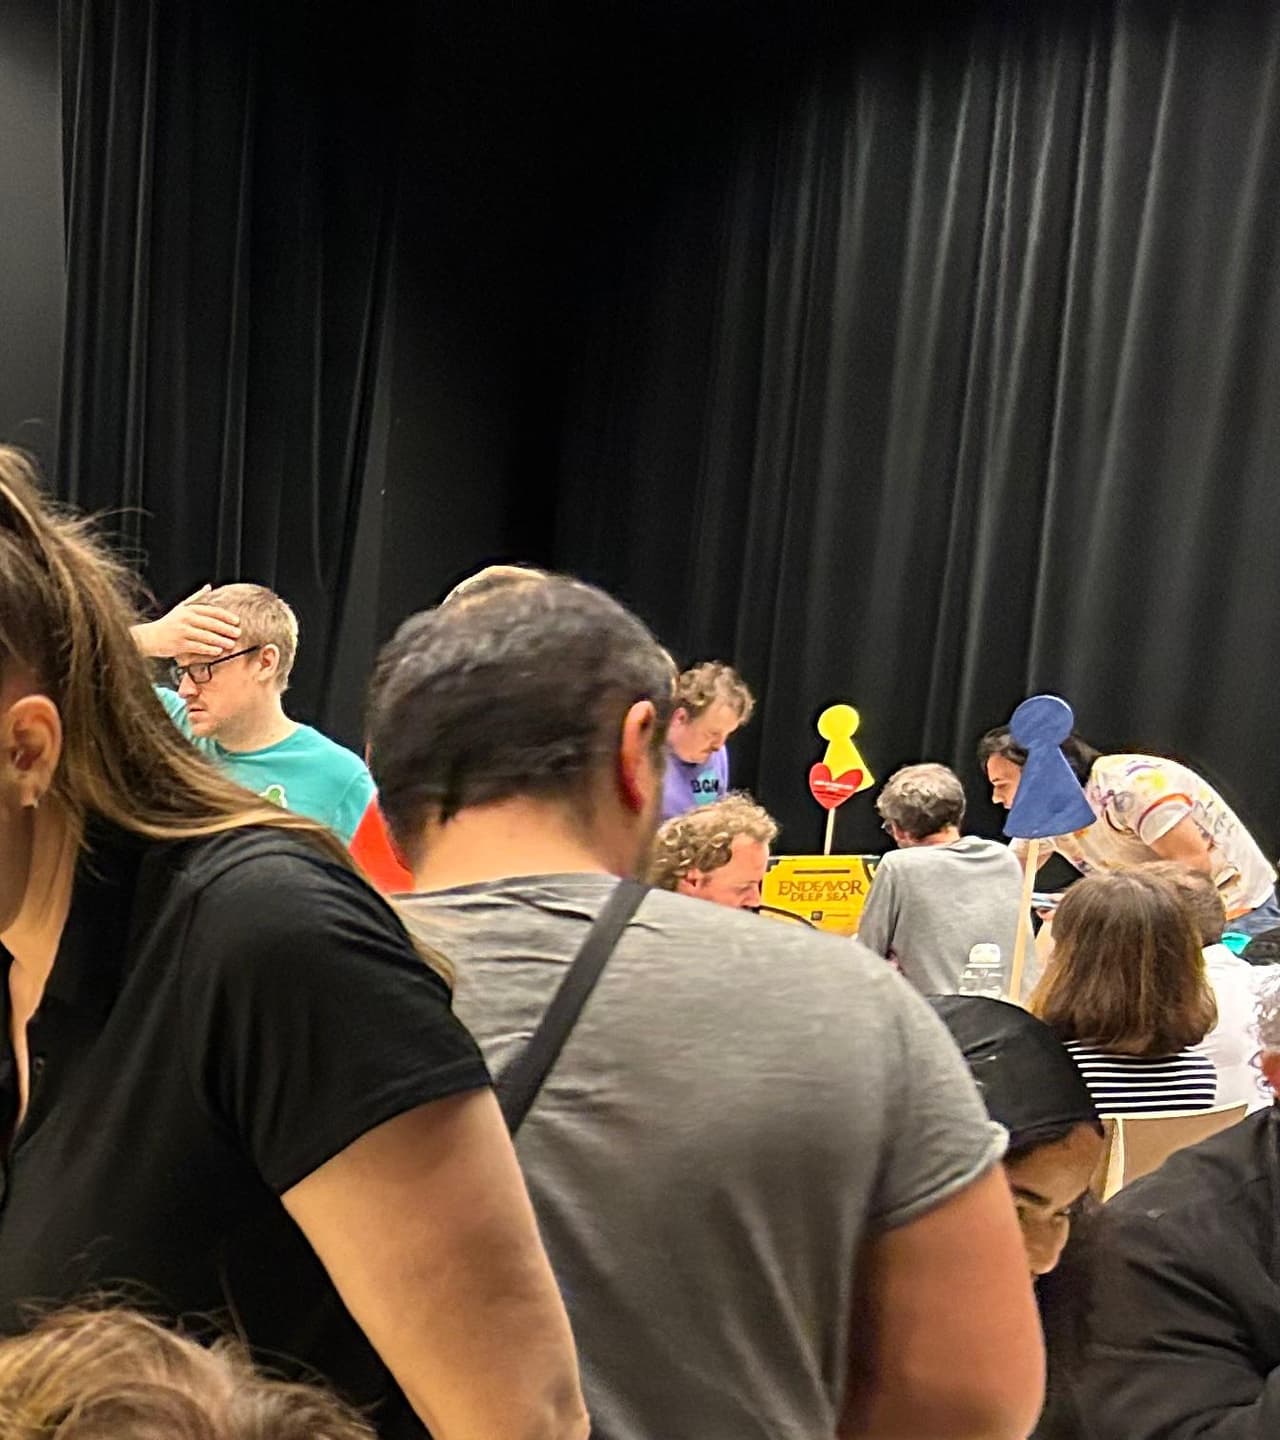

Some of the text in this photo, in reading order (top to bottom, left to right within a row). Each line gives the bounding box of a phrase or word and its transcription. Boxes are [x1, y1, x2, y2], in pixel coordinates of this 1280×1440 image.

[778, 879, 864, 896] ENDEAVOR
[790, 891, 849, 902] DEEP SEA
